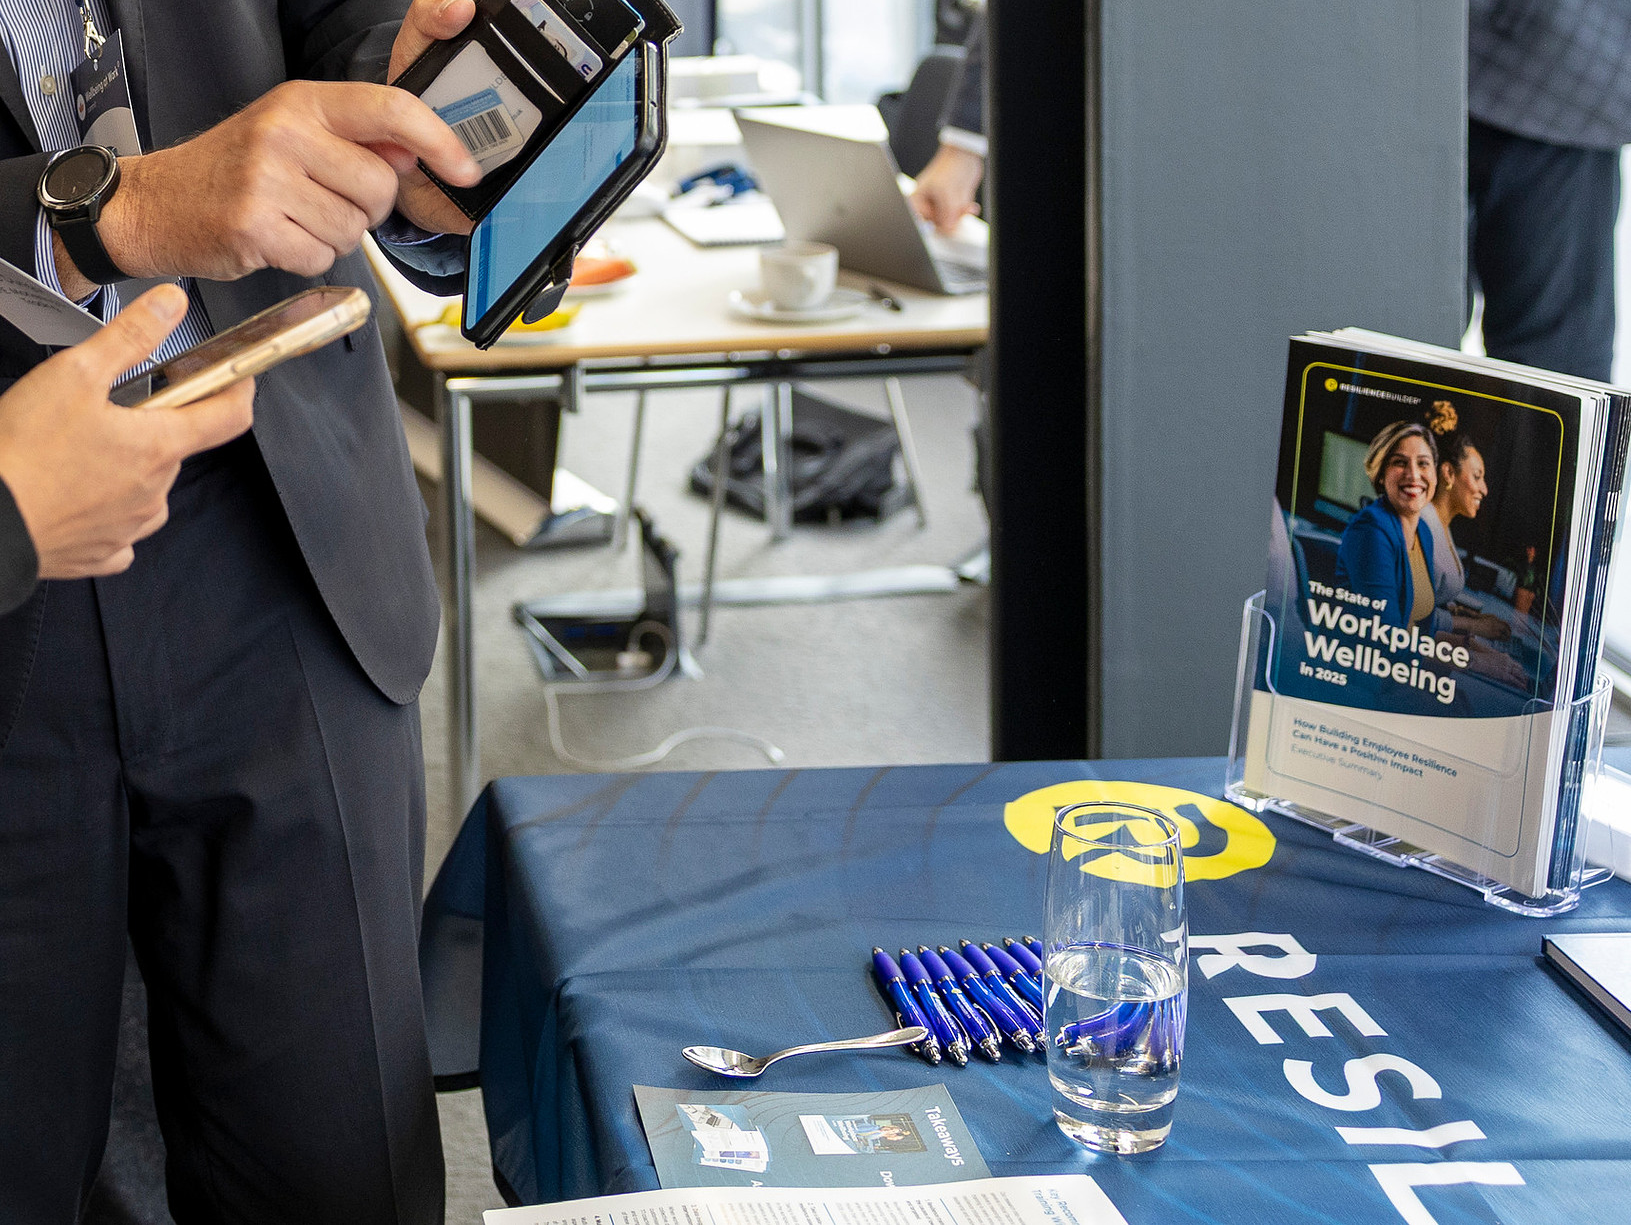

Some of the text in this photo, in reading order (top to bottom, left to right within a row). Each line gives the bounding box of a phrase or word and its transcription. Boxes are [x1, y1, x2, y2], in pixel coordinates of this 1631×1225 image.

[1308, 580, 1388, 612] The State of
[1307, 598, 1470, 668] Workplace
[1299, 661, 1348, 687] in 2025
[1304, 631, 1457, 705] Wellbeing
[1292, 730, 1312, 742] Can
[1314, 736, 1339, 750] Have
[1350, 746, 1388, 765] Positive
[1390, 760, 1424, 778] Impact
[1294, 718, 1458, 777] How Building Employee Resilience
[925, 1105, 965, 1167] Takeaways
